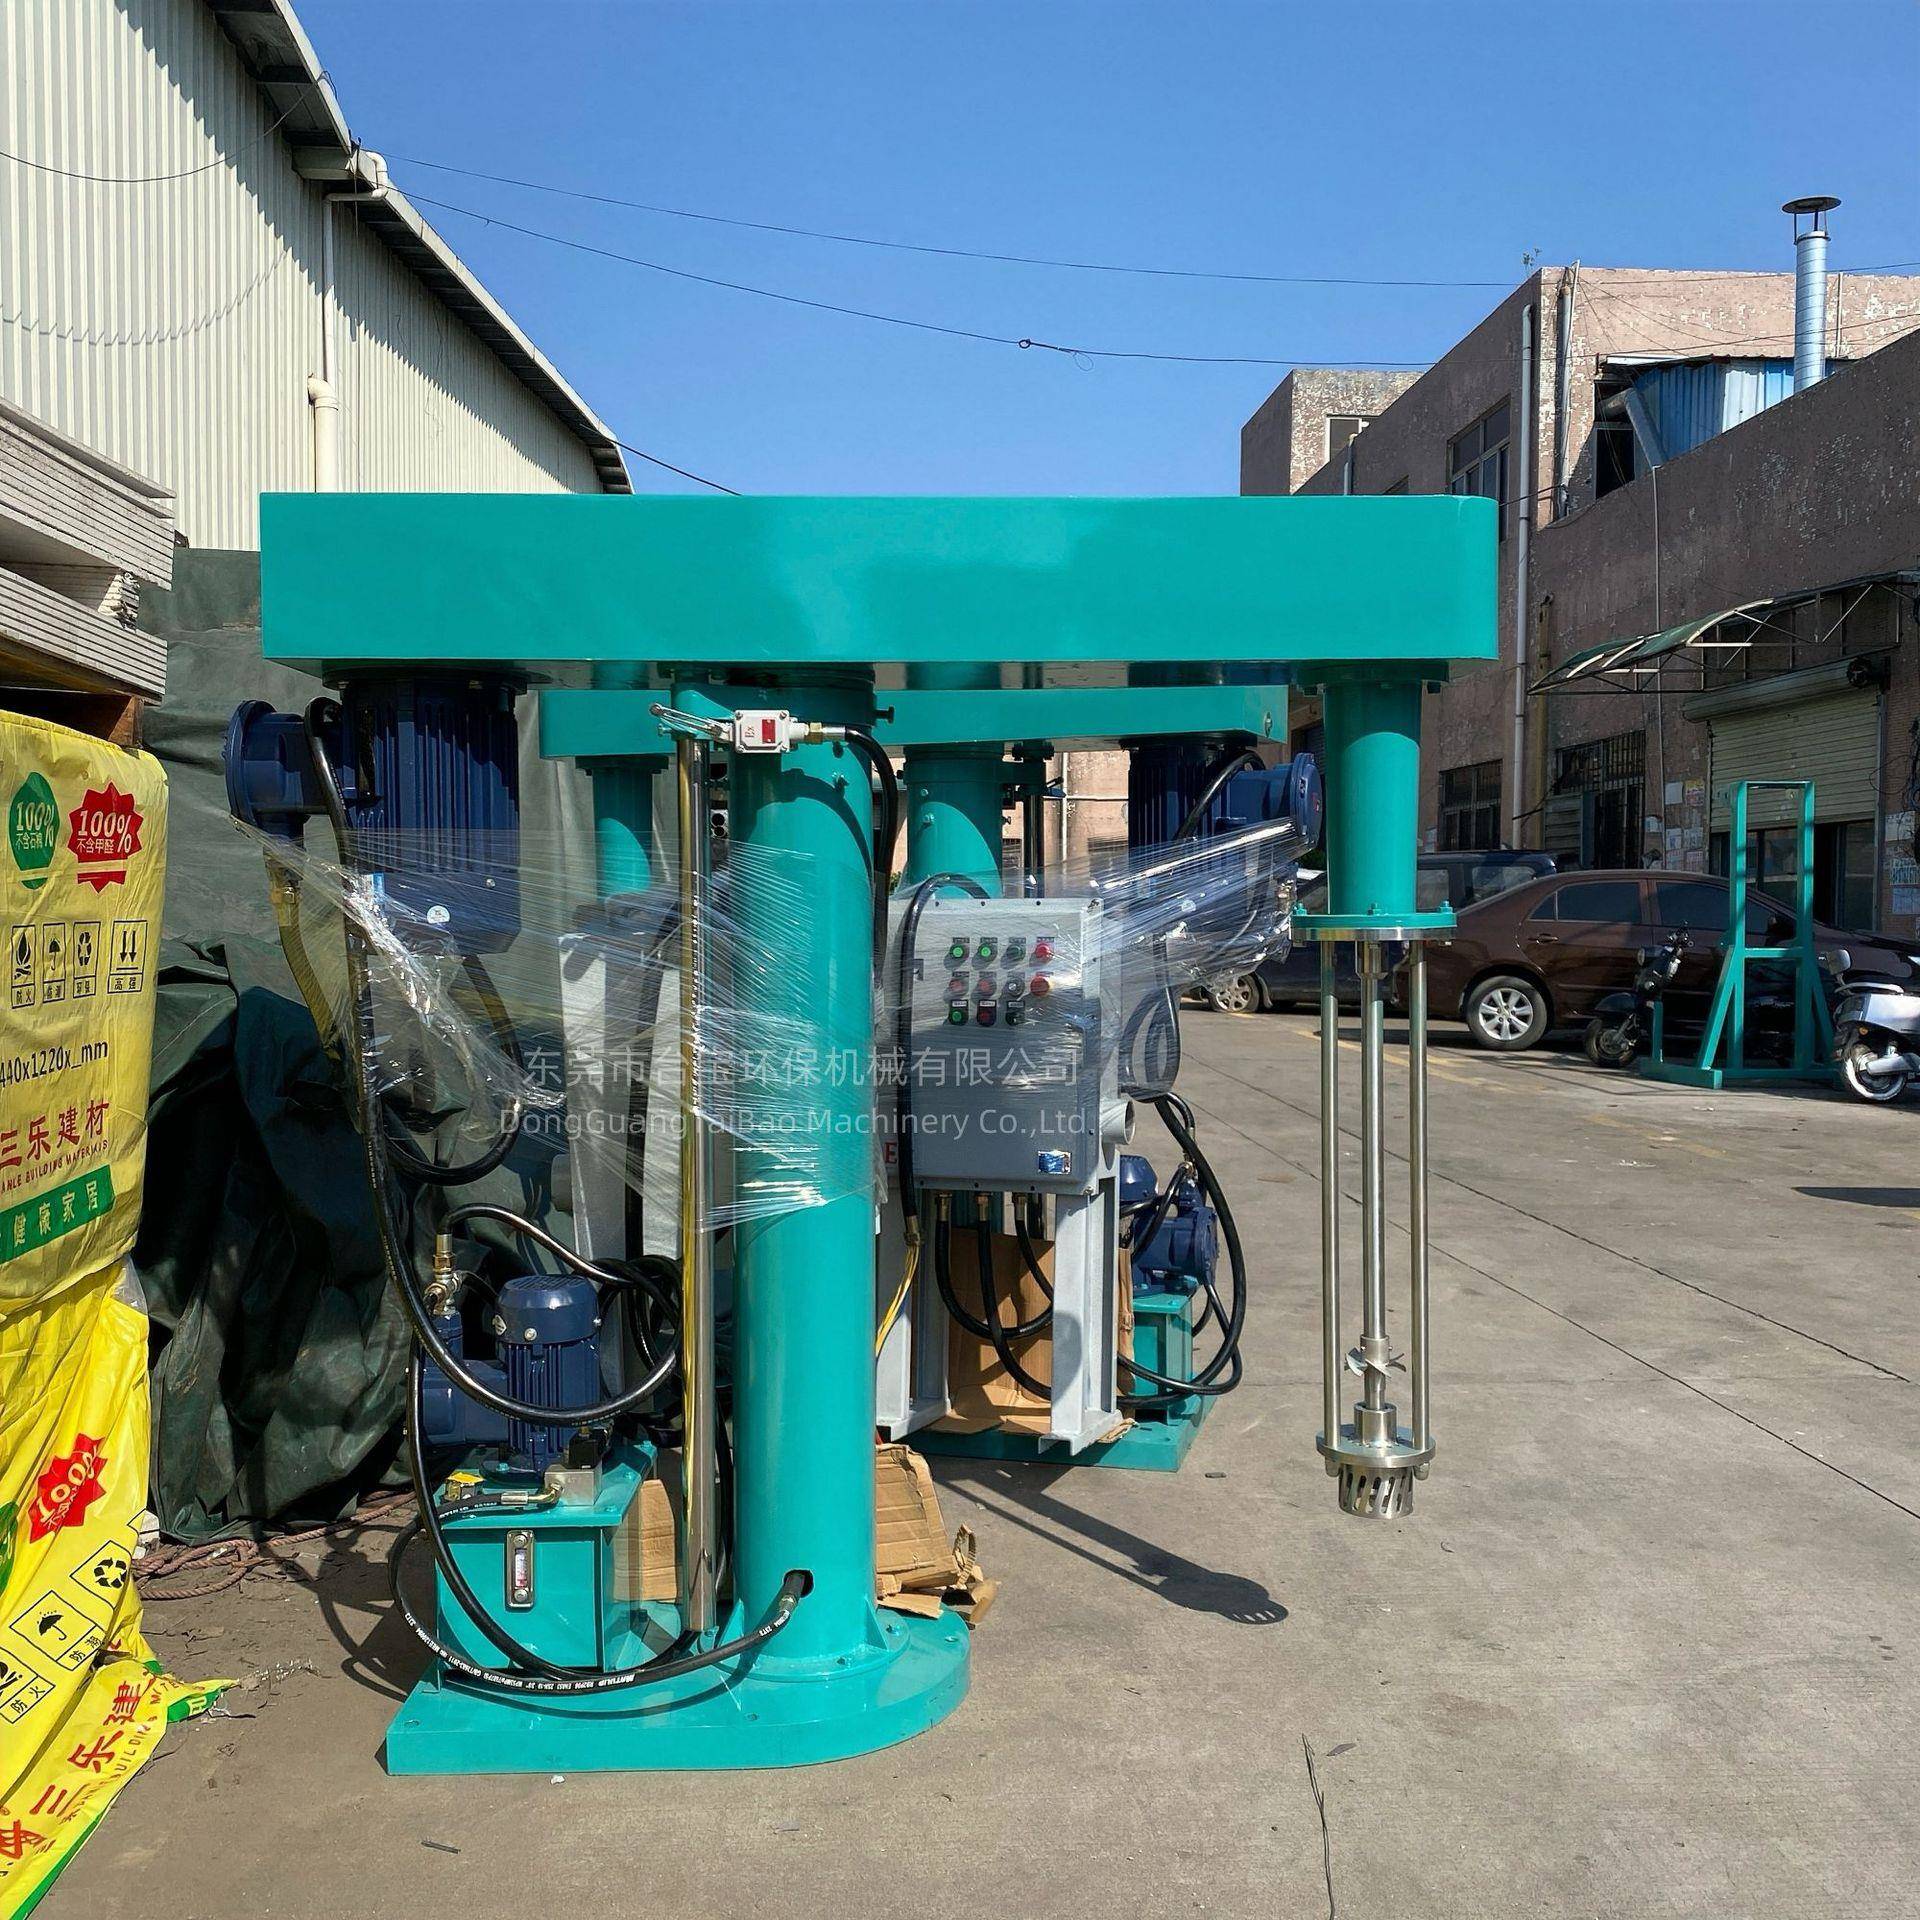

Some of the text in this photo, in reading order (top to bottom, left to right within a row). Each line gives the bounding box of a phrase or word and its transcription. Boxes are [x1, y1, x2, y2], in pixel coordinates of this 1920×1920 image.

[16, 802, 55, 848] 100%
[77, 810, 133, 854] 100%
[76, 837, 115, 854] 不含甲醛
[16, 989, 33, 1004] 防火
[0, 1099, 110, 1169] 三乐建材
[25, 1160, 63, 1184] BUILDING
[9, 1684, 46, 1714] 防火
